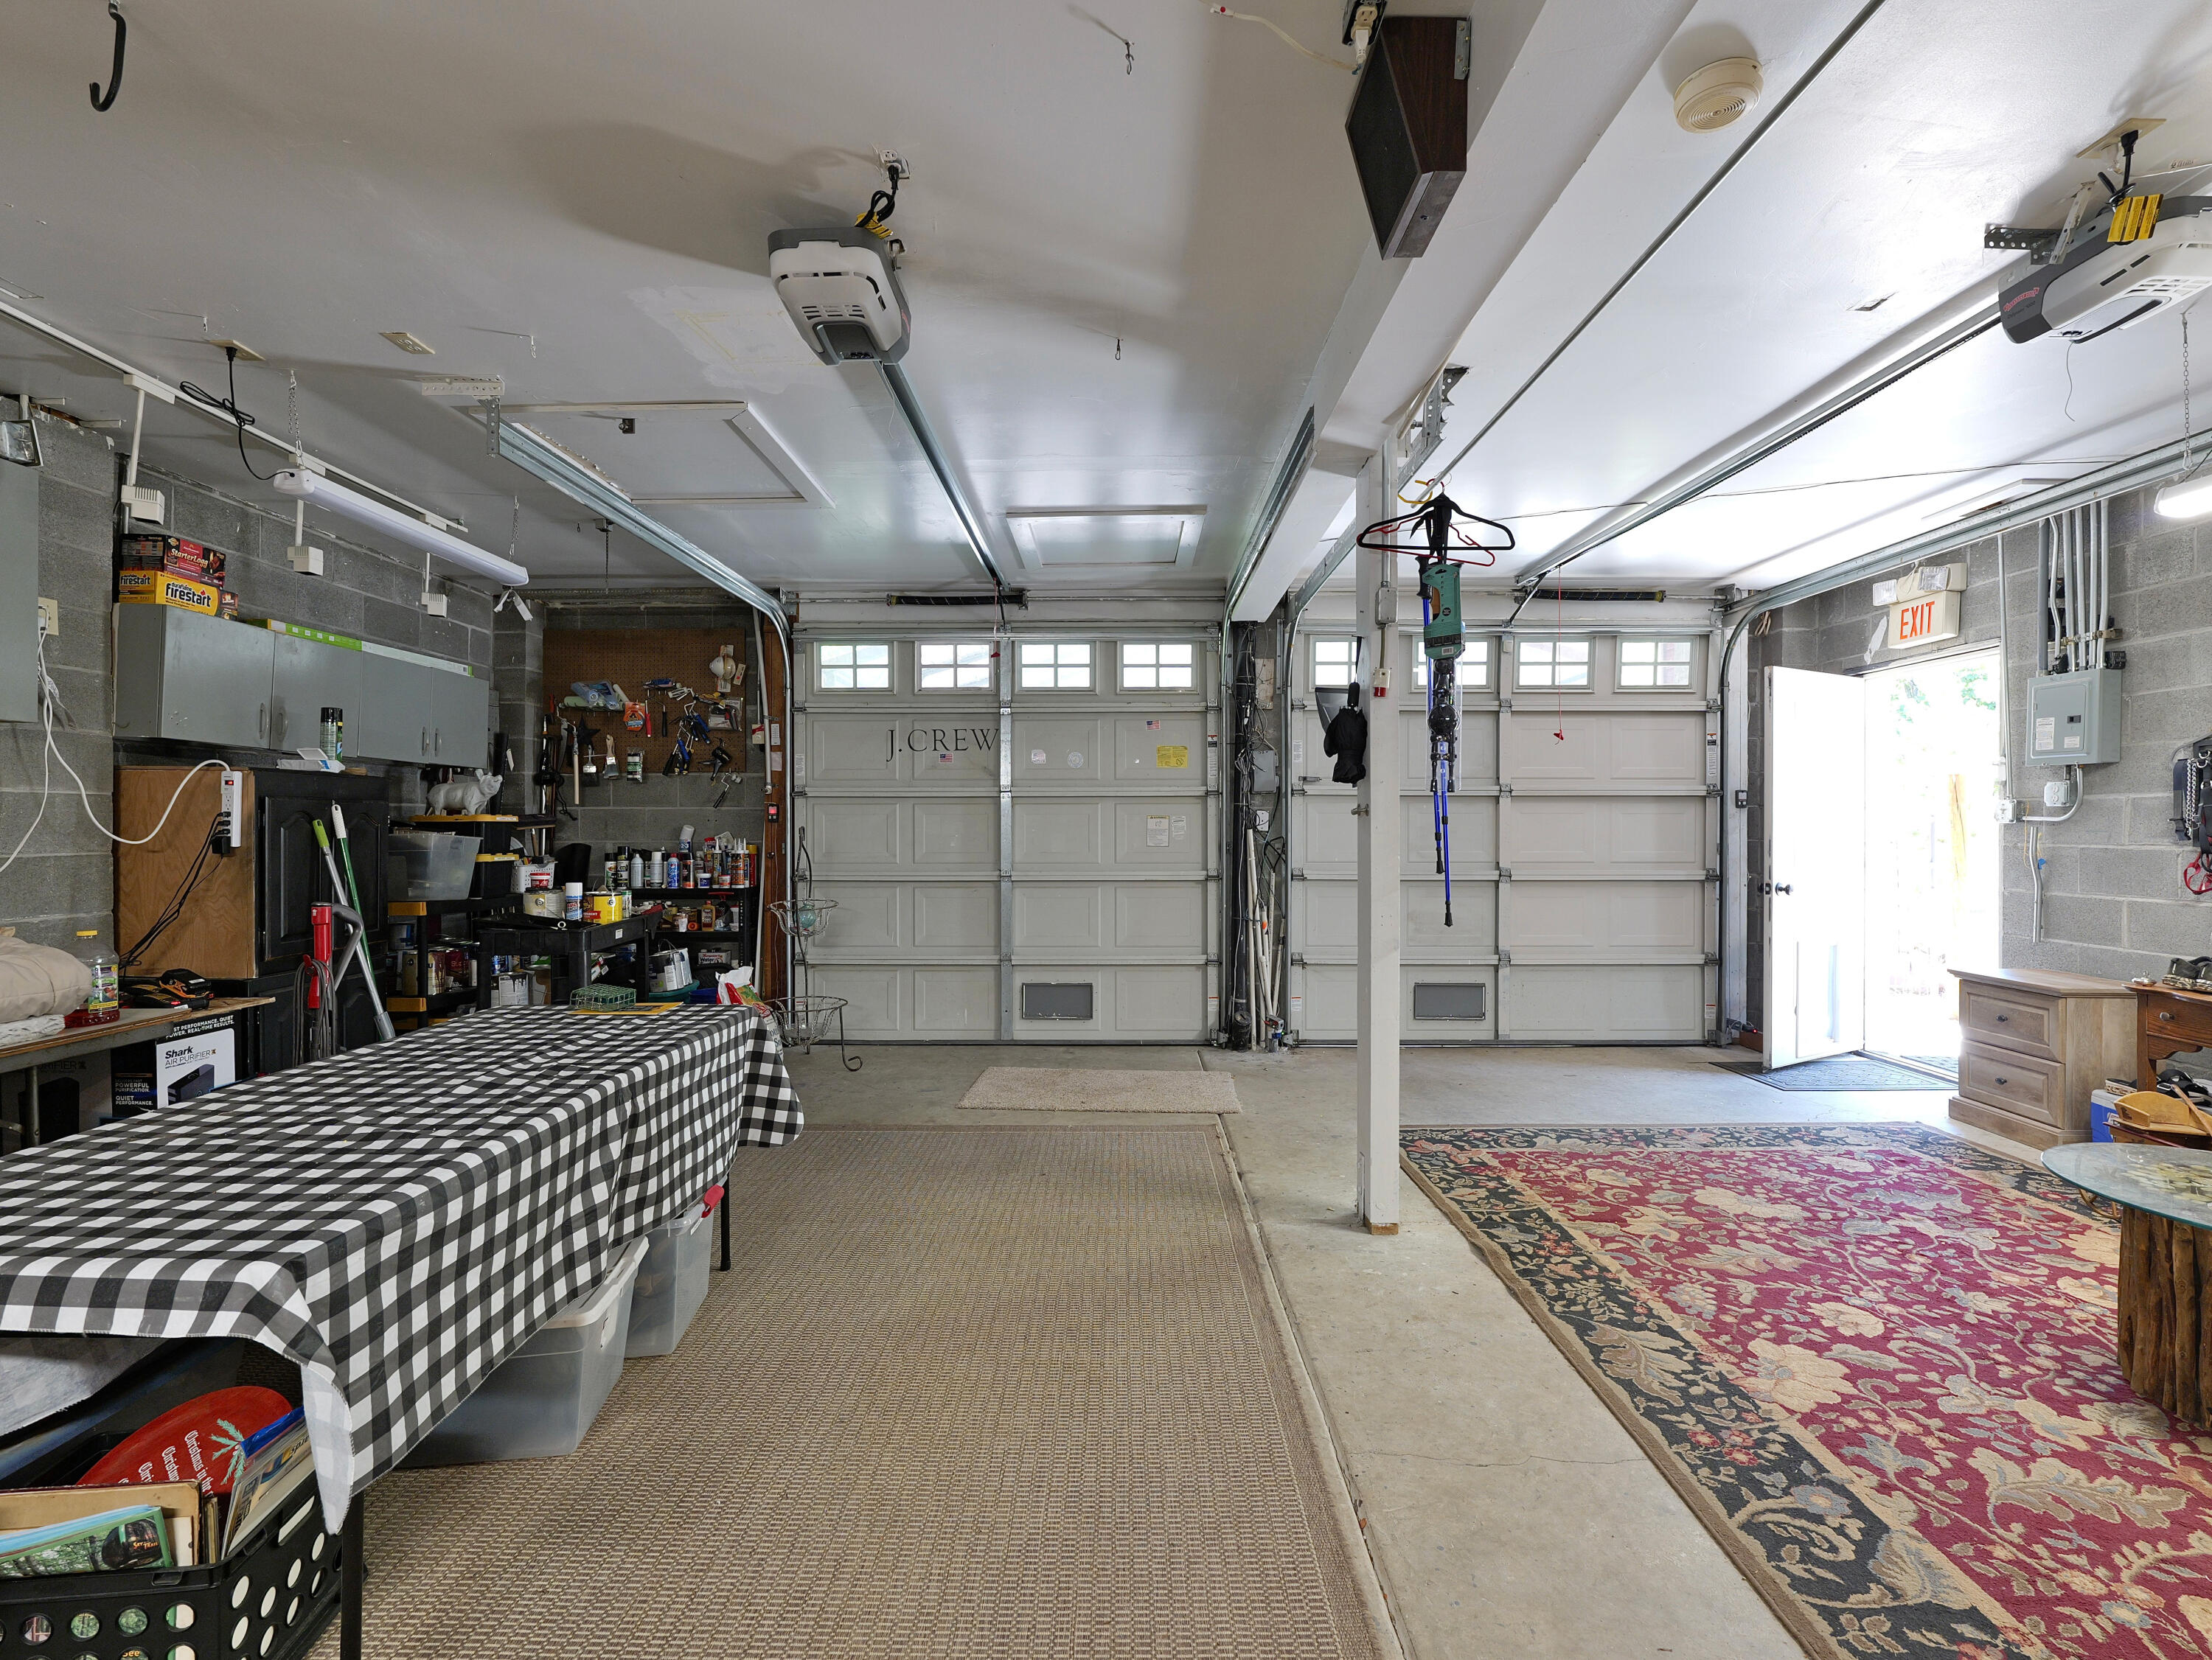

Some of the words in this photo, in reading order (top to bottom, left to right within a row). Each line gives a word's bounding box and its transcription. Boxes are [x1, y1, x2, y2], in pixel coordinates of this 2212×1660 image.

[170, 548, 209, 568] StarterLogg
[120, 575, 150, 585] firestart
[165, 582, 212, 607] firestart
[1899, 601, 1935, 640] EXIT
[181, 1018, 219, 1030] PERFORMANCE.
[213, 1019, 234, 1028] RESULTS.
[164, 1046, 194, 1059] Shark
[164, 1057, 178, 1067] AIR
[179, 1050, 211, 1063] PURIFIER
[184, 1430, 204, 1472] Christmas
[161, 1445, 180, 1481] Christm
